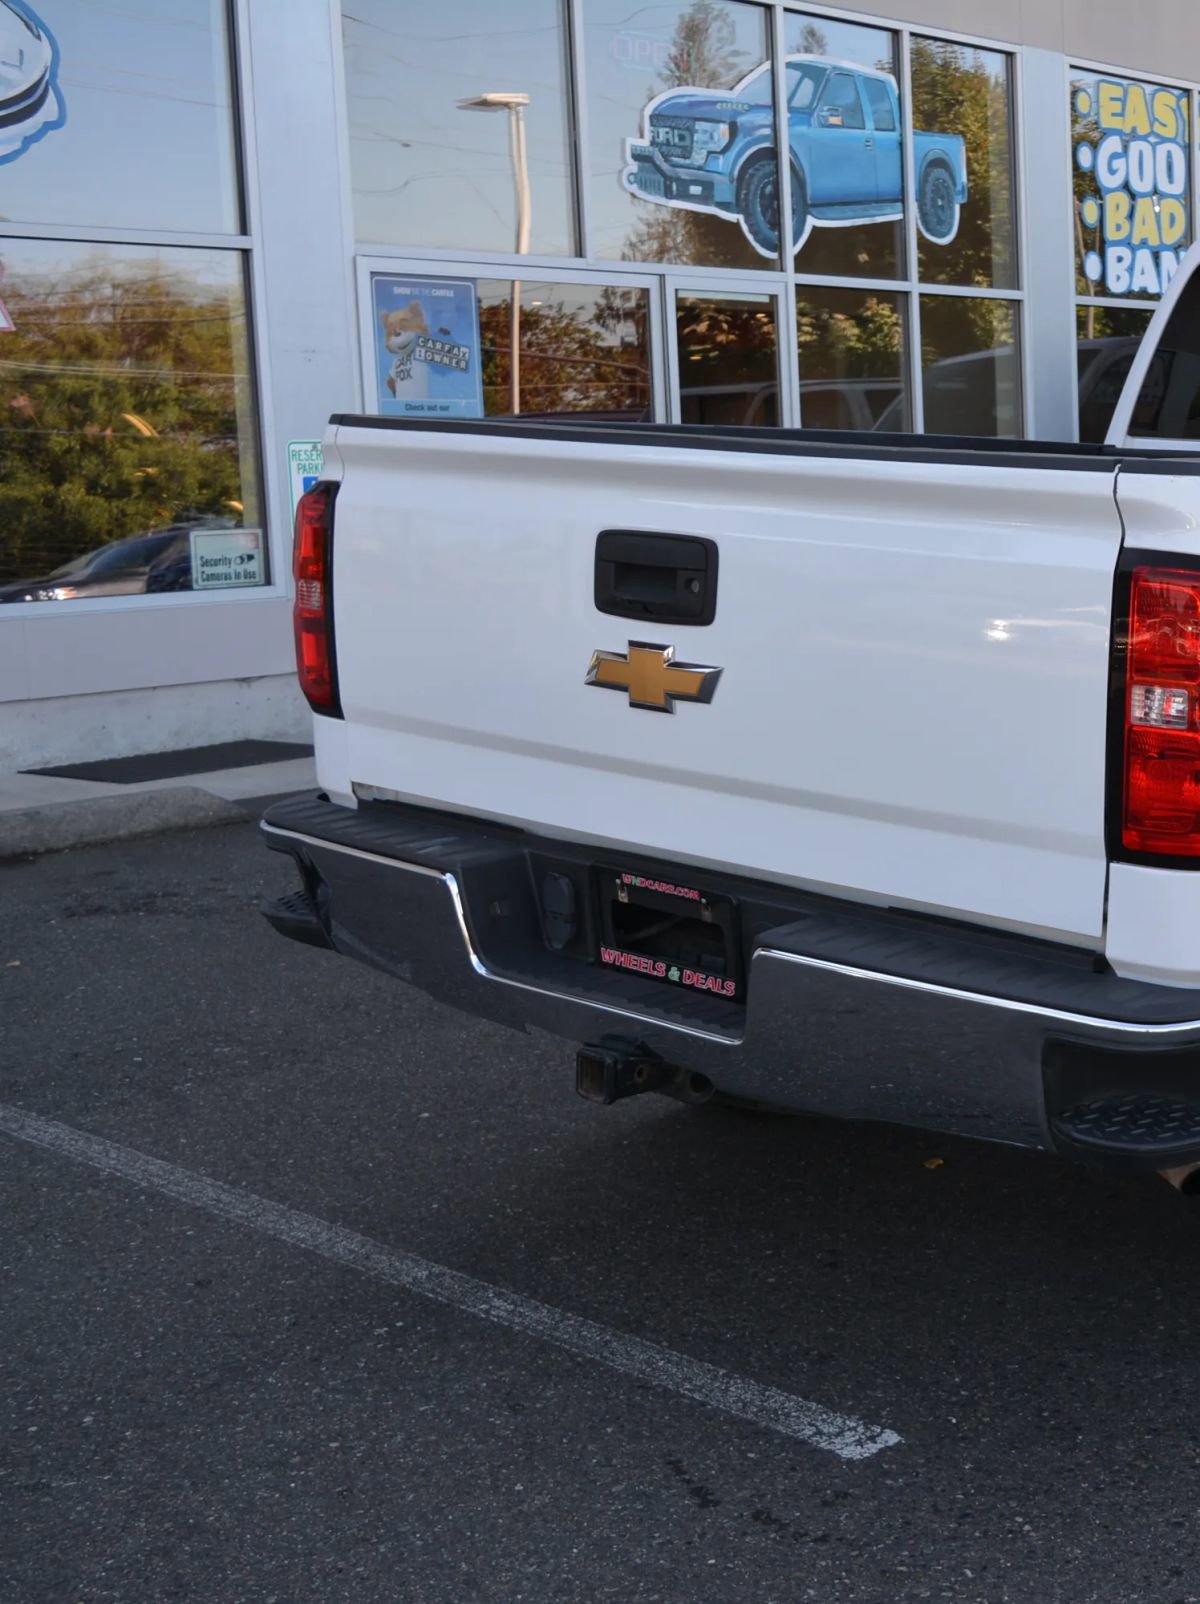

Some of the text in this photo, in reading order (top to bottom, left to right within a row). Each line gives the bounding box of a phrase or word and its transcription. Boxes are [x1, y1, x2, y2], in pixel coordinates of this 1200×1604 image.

[1103, 190, 1187, 247] BAD
[418, 336, 469, 361] CARFAX
[199, 555, 232, 568] Security
[201, 571, 232, 582] Cameras
[601, 947, 736, 996] WHEELS & DEALS
